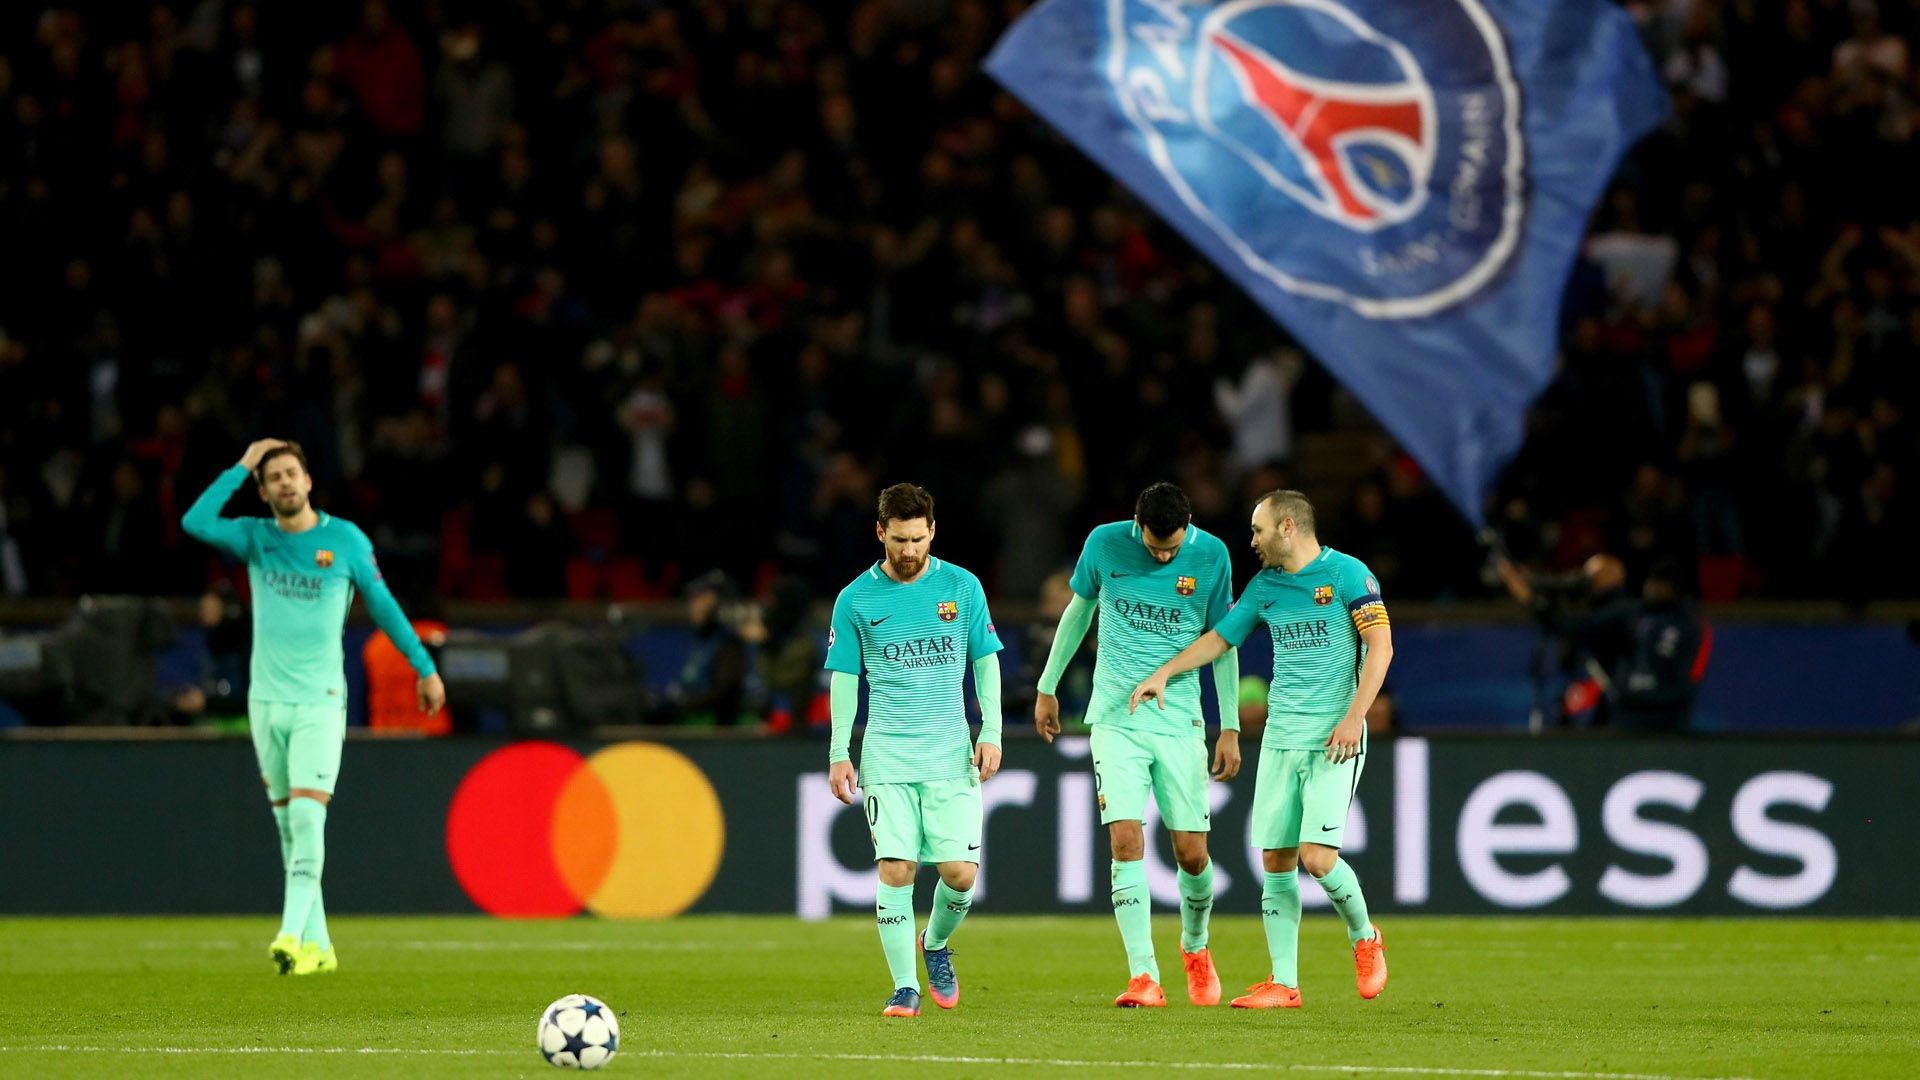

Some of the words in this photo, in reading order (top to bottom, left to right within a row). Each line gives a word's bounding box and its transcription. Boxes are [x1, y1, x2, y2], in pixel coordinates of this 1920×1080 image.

[262, 569, 322, 589] QATAR
[1115, 599, 1182, 624] QATAR
[1129, 619, 1181, 635] AIRWAYS
[1272, 620, 1328, 644] QATAR
[883, 635, 954, 662] QATAR
[902, 653, 956, 669] AIRWAYS
